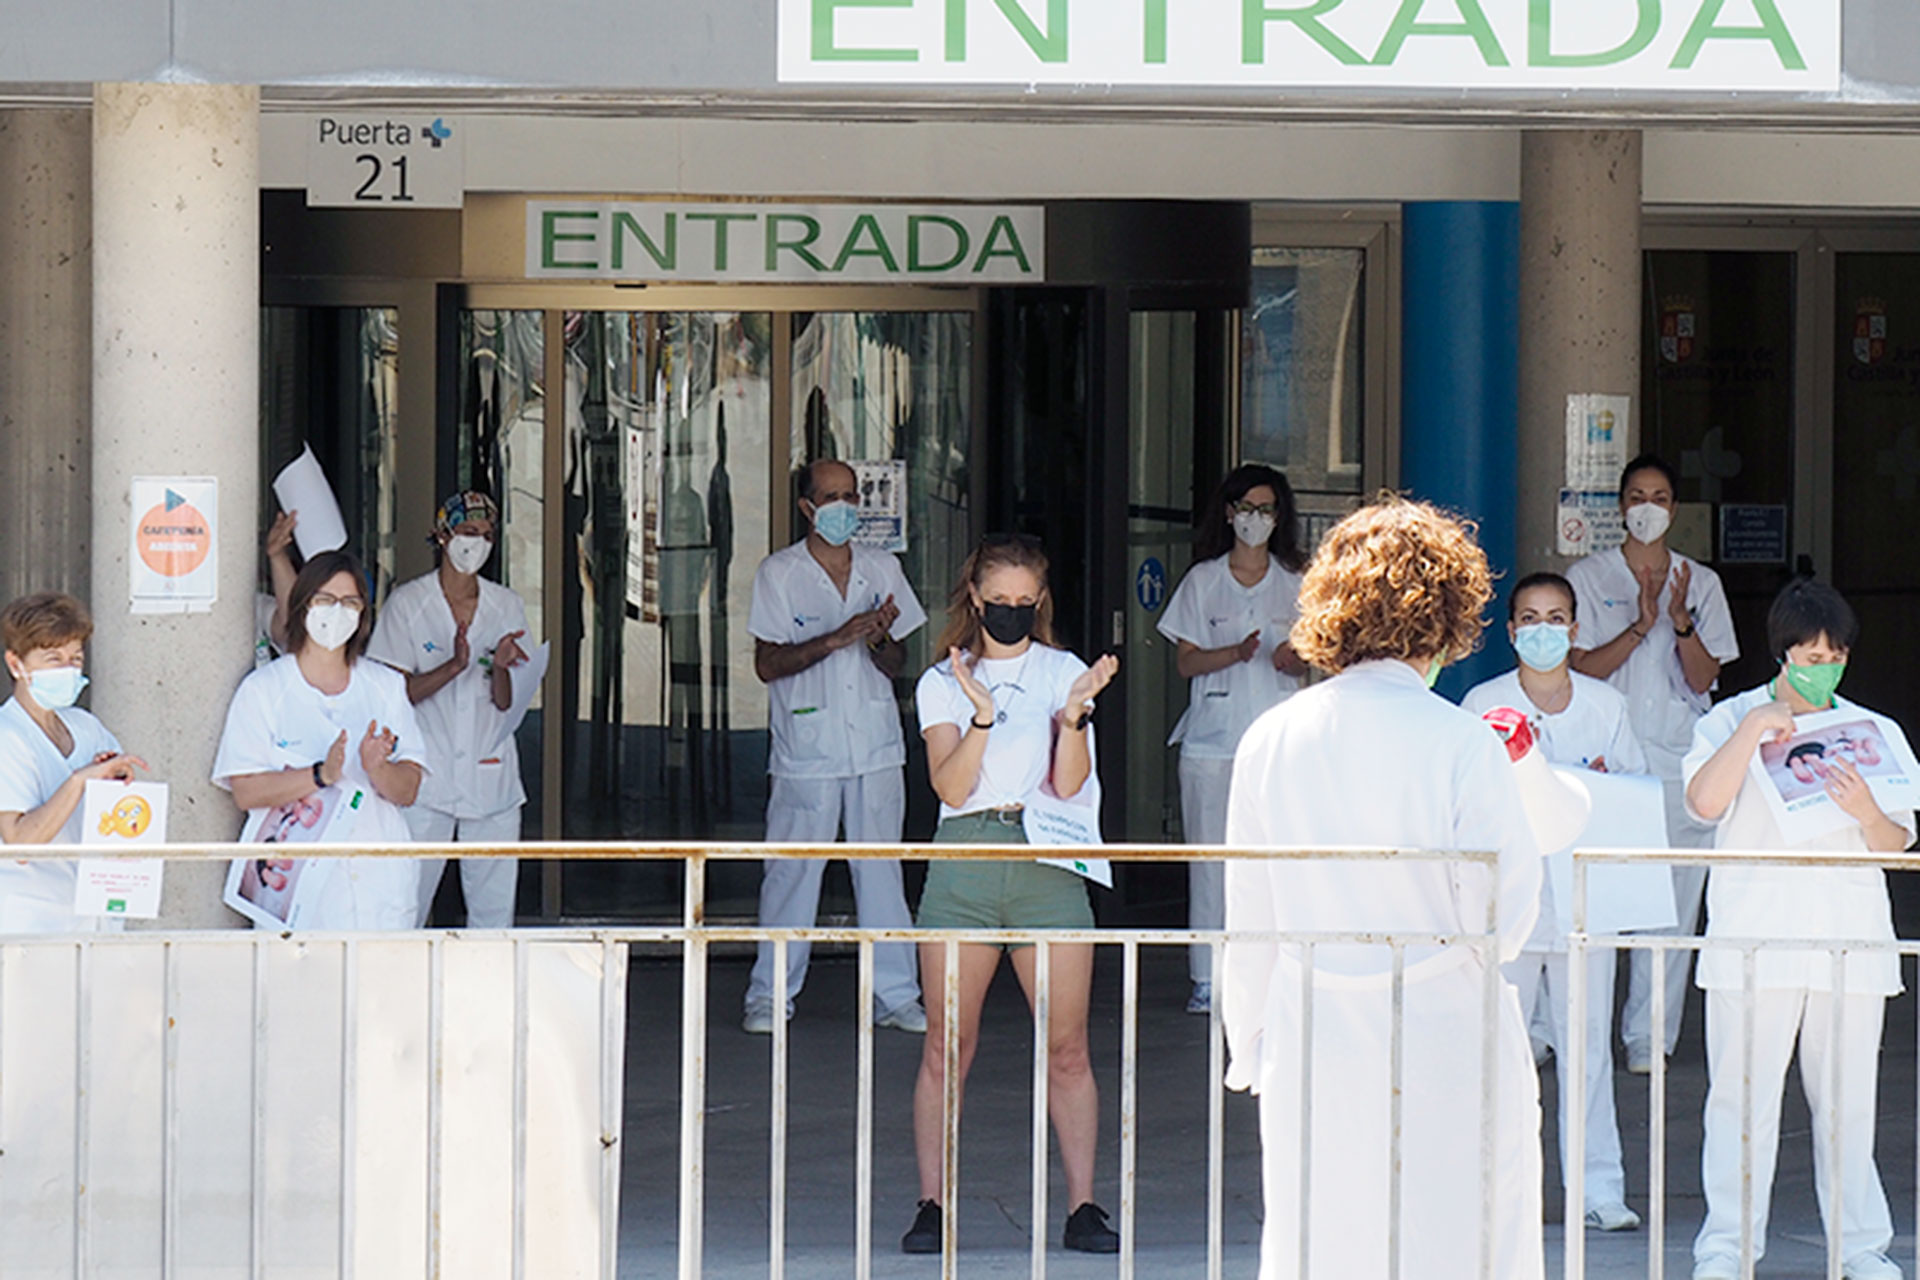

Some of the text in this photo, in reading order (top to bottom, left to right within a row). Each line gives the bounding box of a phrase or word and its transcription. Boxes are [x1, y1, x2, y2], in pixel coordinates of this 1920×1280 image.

[810, 0, 1807, 70] ENTRADA
[319, 118, 412, 146] Puerta
[354, 154, 414, 202] 21
[542, 211, 1031, 274] ENTRADA
